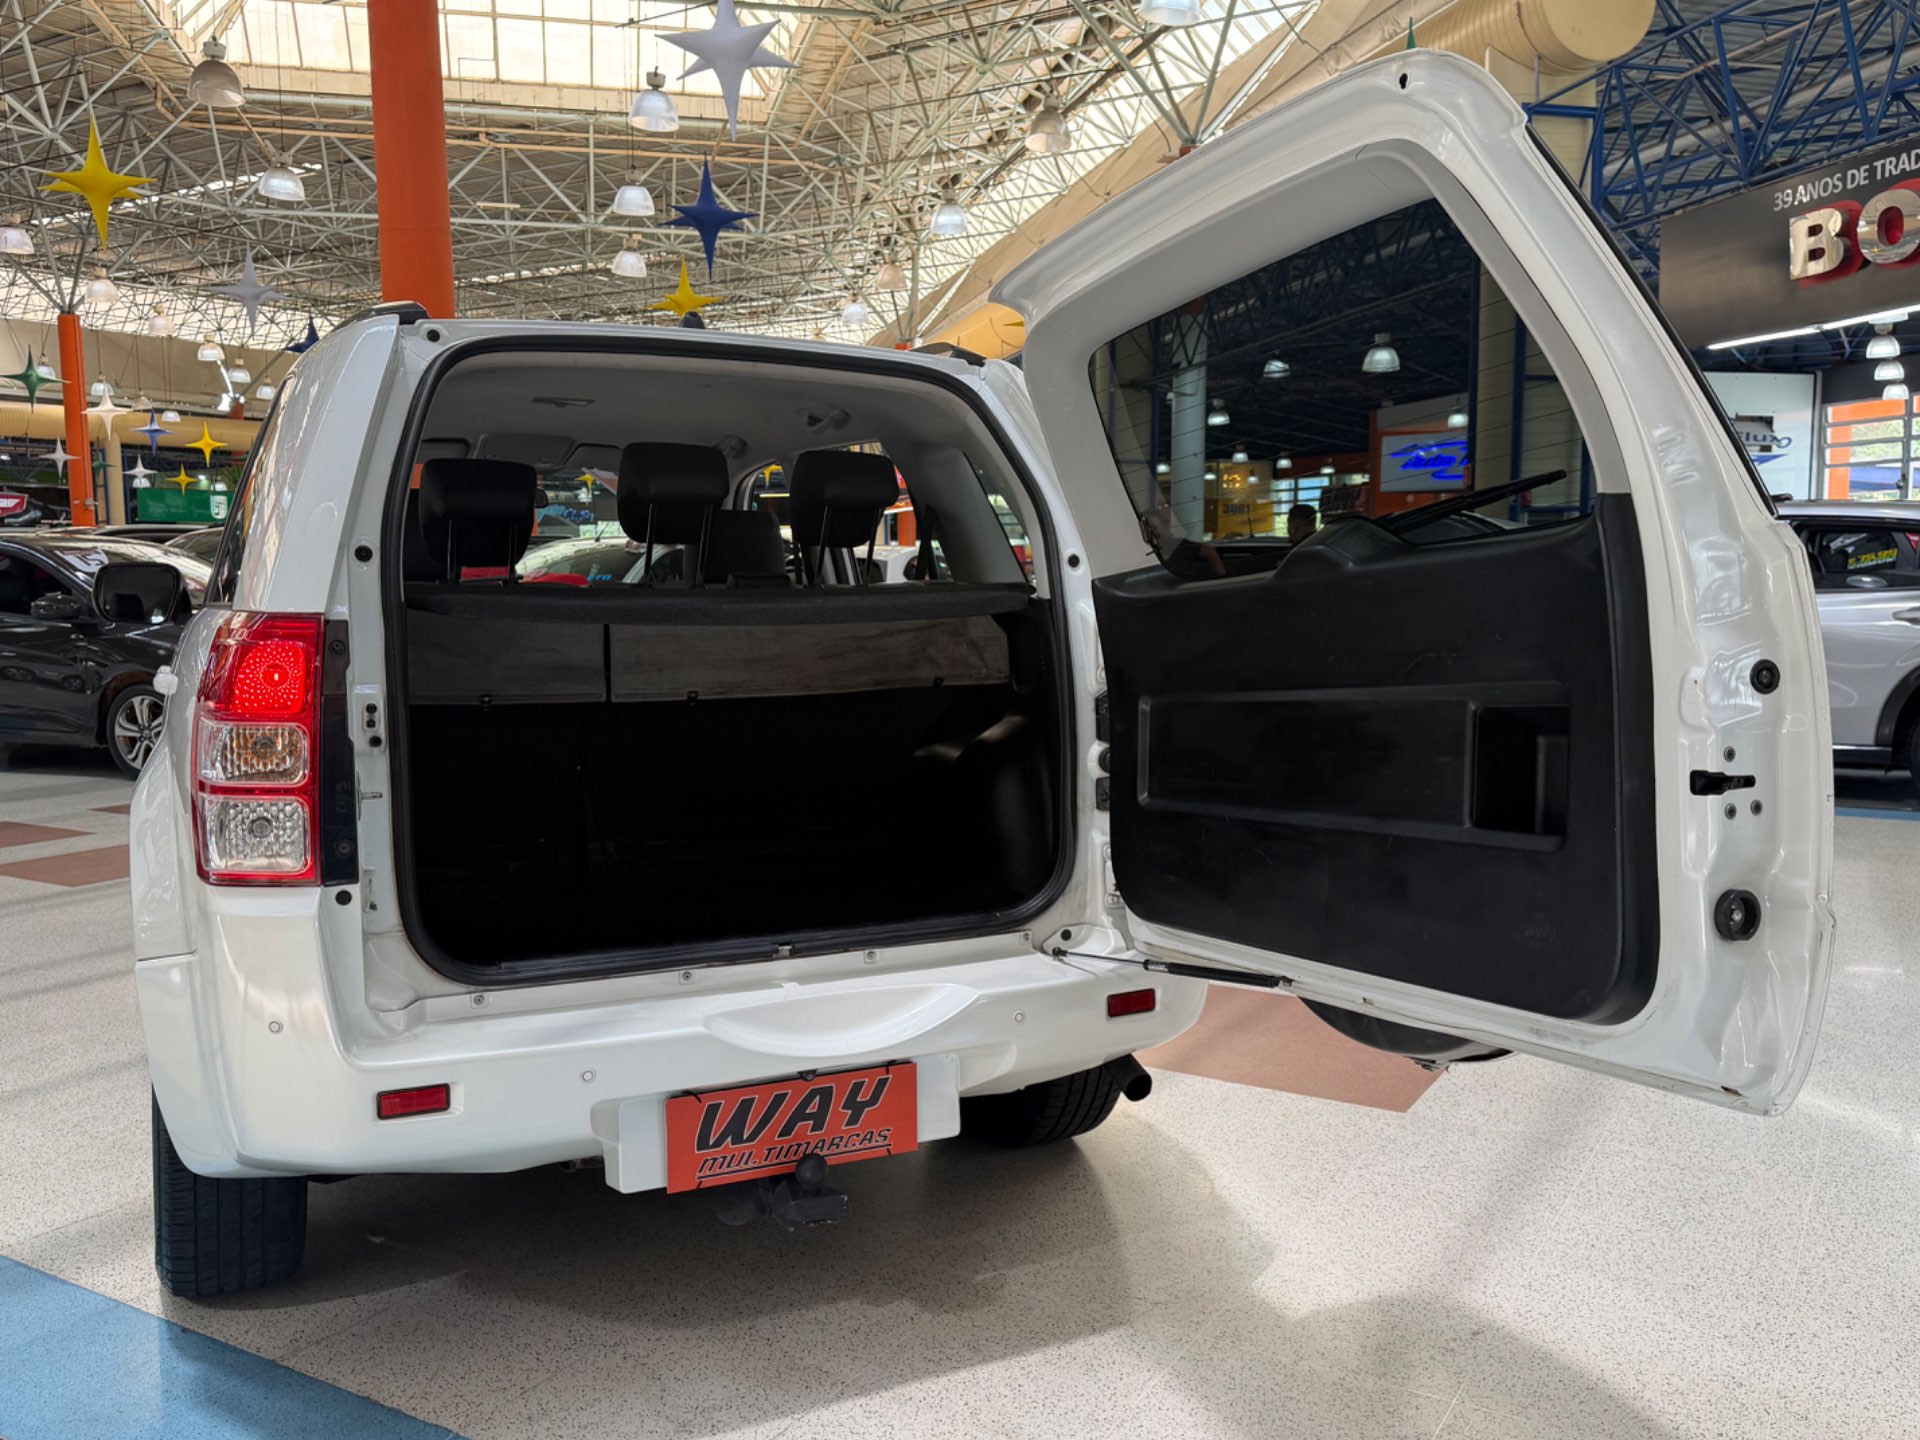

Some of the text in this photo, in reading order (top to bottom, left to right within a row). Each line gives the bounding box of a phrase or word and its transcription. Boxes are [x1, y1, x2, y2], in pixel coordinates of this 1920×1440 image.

[1773, 148, 1920, 211] 39 ANOS DE TRAD
[1789, 188, 1920, 280] BO
[695, 1075, 892, 1153] WAY
[697, 1127, 893, 1175] MULTIMARCAS
